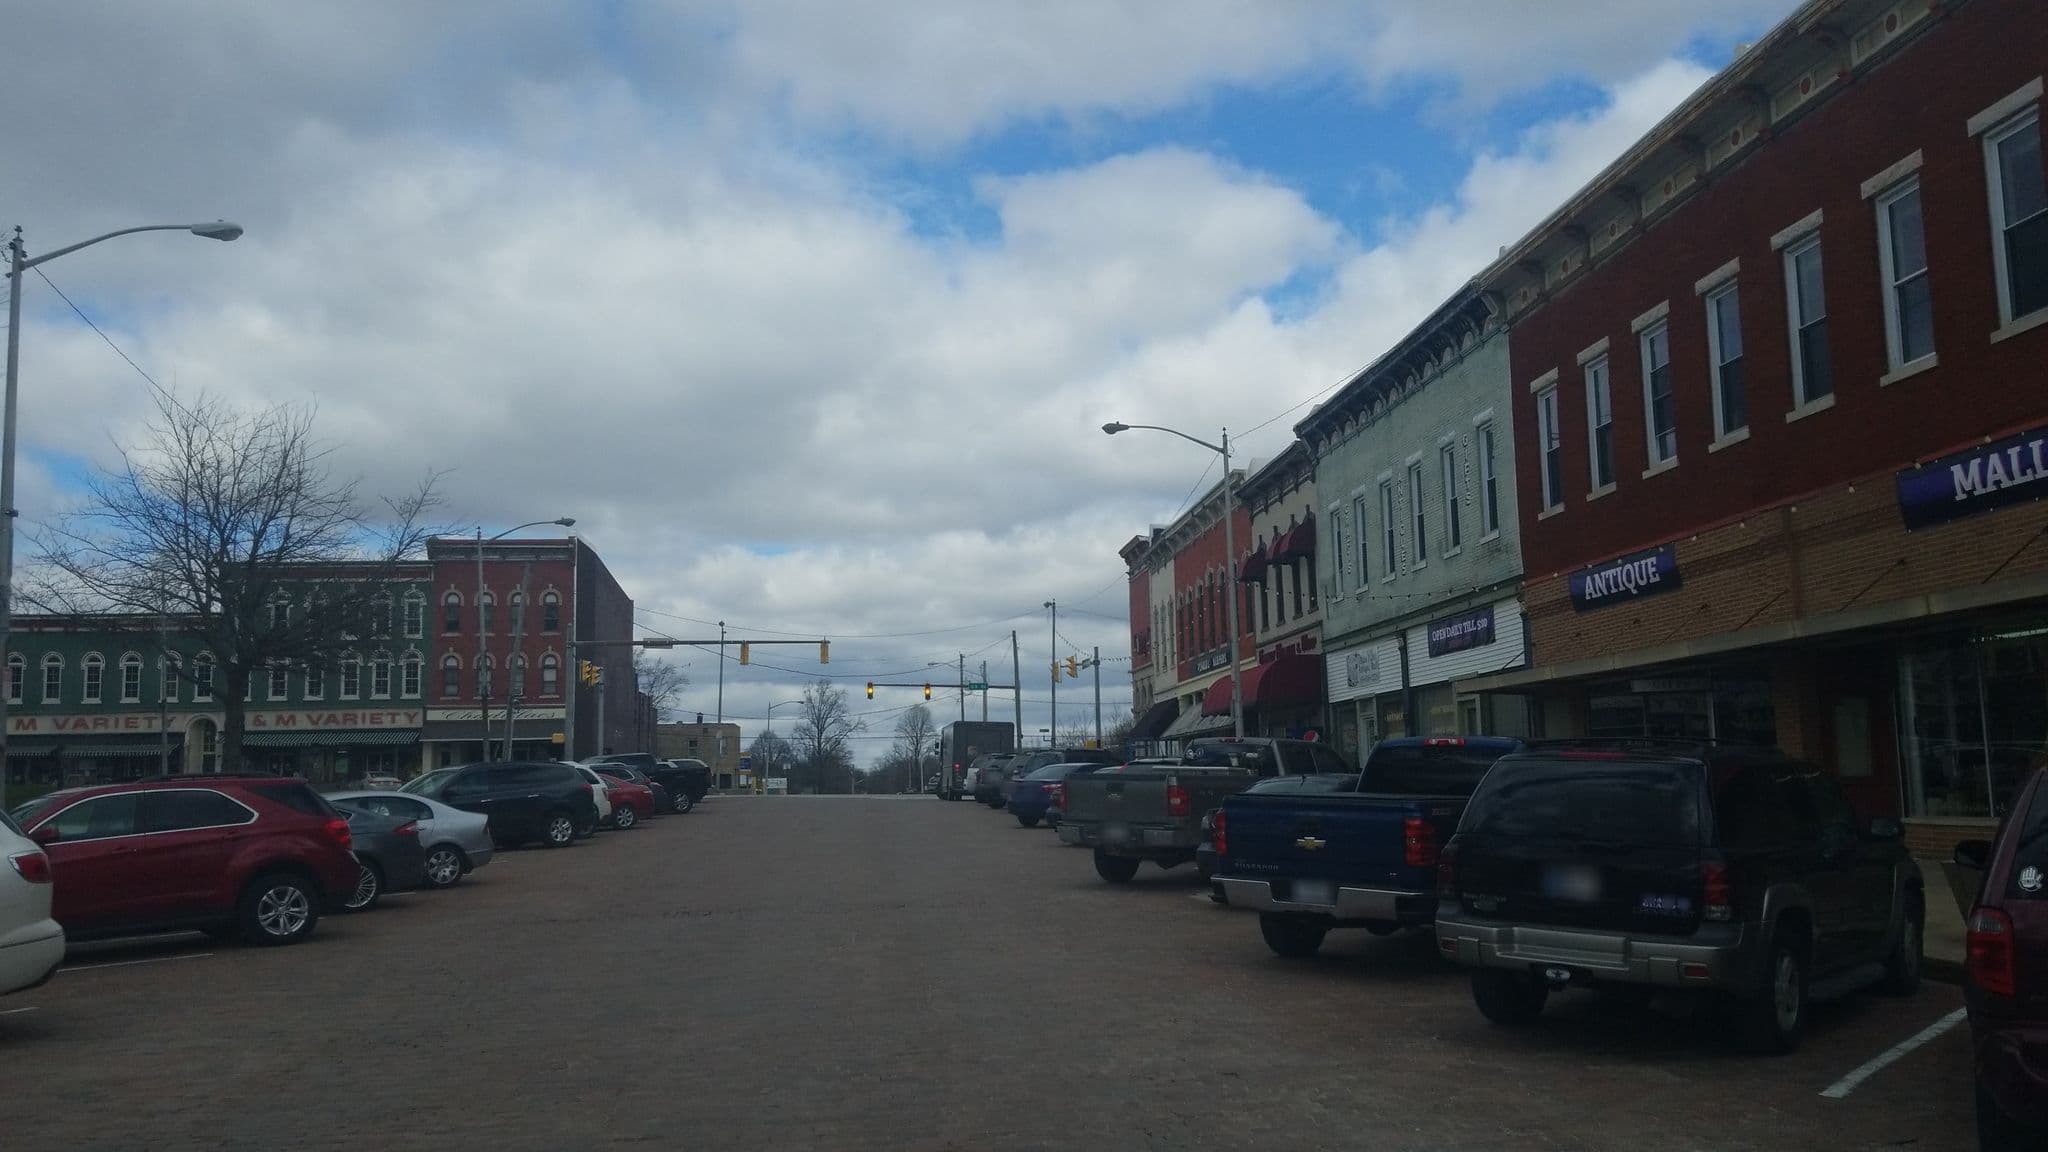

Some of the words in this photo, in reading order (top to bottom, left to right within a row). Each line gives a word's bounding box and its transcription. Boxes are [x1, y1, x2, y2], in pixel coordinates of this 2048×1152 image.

[1950, 438, 2048, 501] MALL
[1584, 556, 1661, 600] ANTIQUE
[1431, 628, 1446, 642] OPEN
[1446, 623, 1463, 638] DAILY
[1462, 619, 1477, 633] TILL
[15, 717, 38, 731] M
[252, 713, 266, 727] &
[275, 713, 296, 727] M
[306, 711, 418, 727] VARIETY
